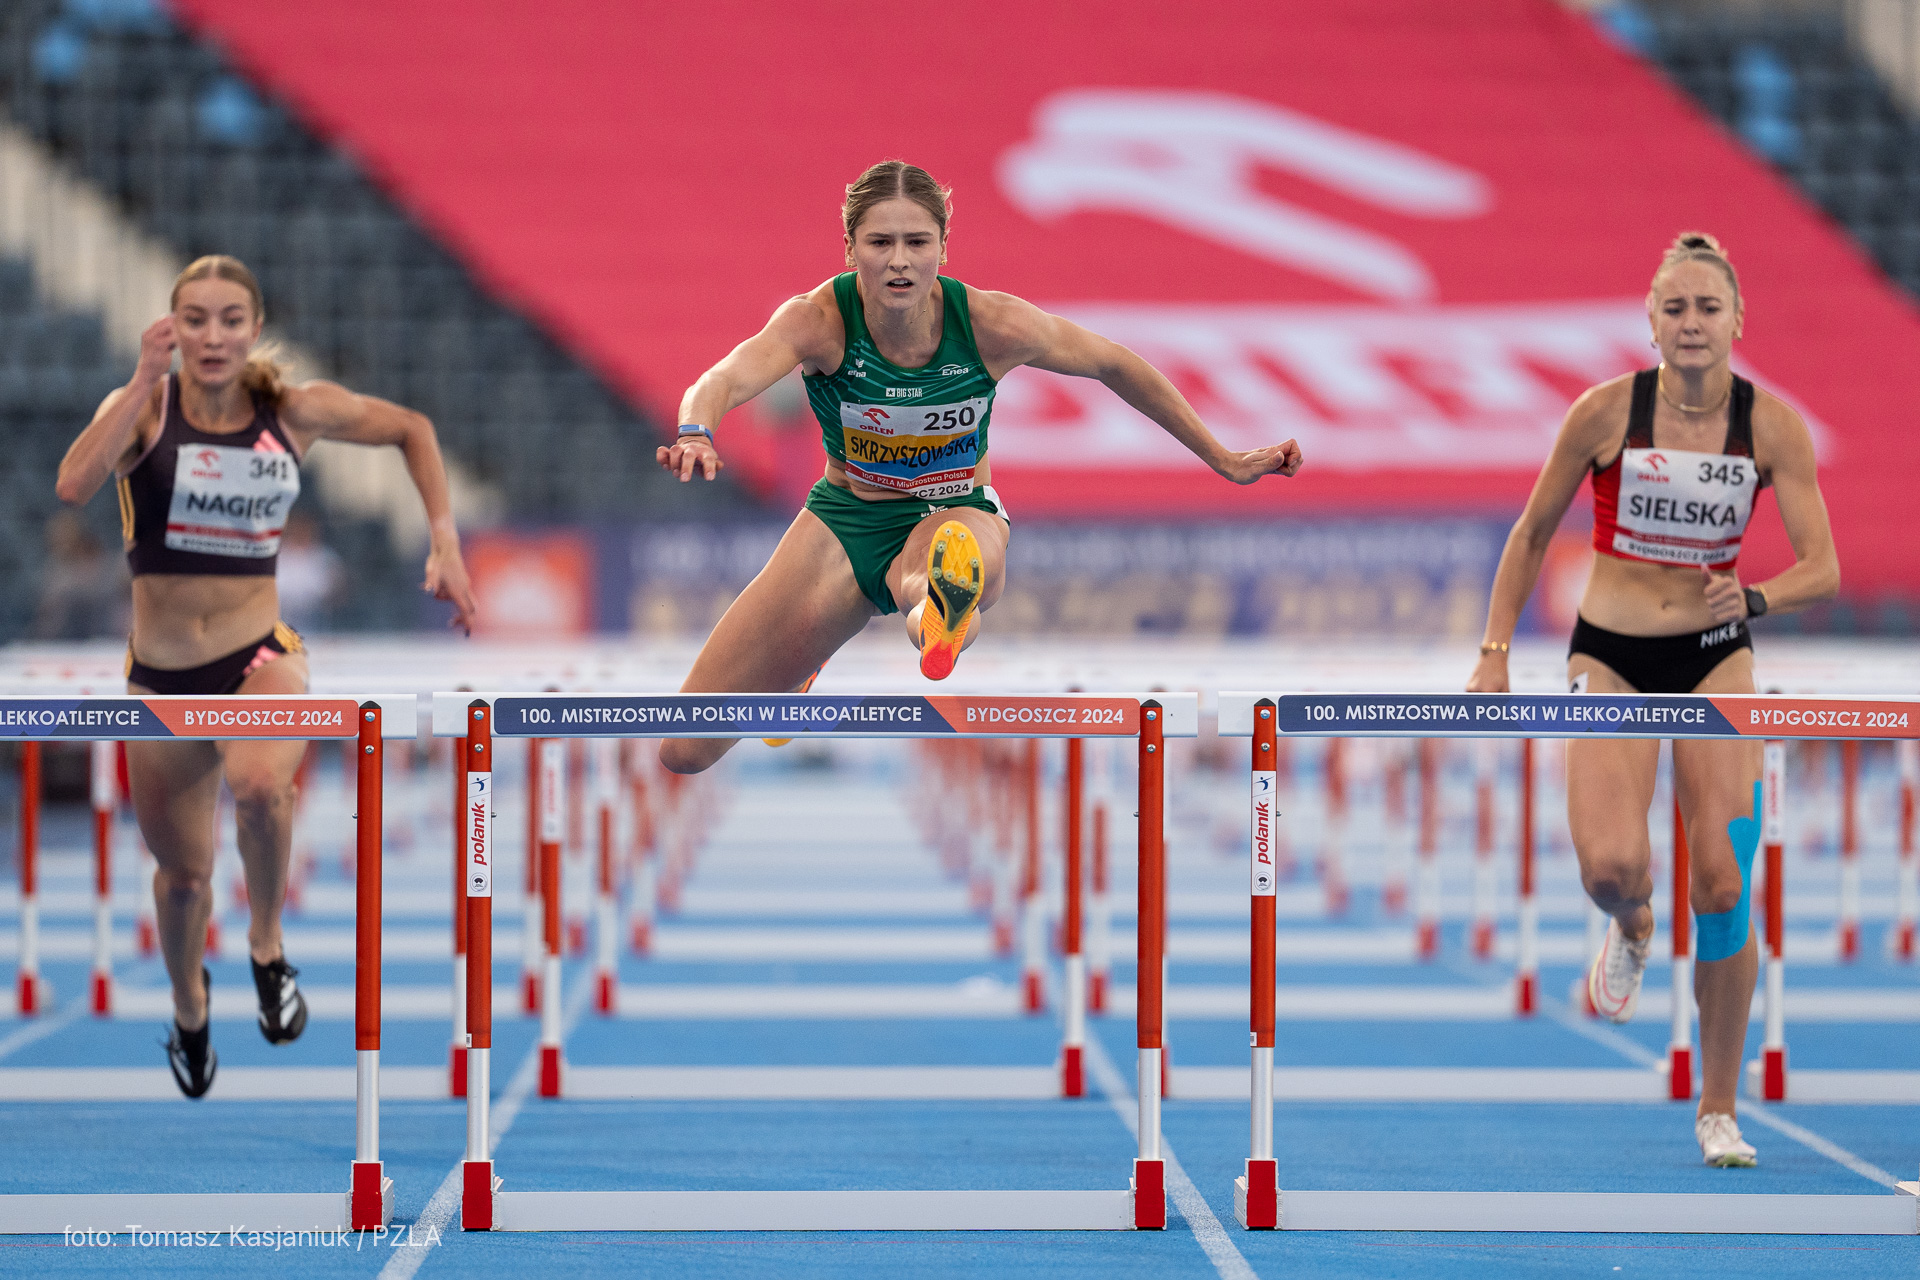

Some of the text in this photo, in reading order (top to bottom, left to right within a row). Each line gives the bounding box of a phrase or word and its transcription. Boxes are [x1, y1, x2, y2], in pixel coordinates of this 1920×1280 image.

[942, 366, 969, 376] Enea
[896, 388, 923, 397] BIG STAR
[859, 424, 894, 435] ORLEN
[923, 406, 976, 432] 250
[850, 435, 978, 469] SKRZYSZOWSKA
[249, 457, 288, 480] 341
[877, 477, 895, 486] PZLA
[943, 470, 967, 480] Polski
[1698, 462, 1744, 485] 345
[938, 483, 970, 496] 2024
[1629, 494, 1737, 527] SIELSKA
[1700, 621, 1739, 649] NIKE
[184, 710, 295, 726] BYDGOSZCZ
[300, 710, 343, 726] 2024
[520, 706, 1124, 724] 100. MISTRZOSTWA POLSKI W LEKKOATLETYCE BYDGOSZCZ 2024
[1304, 704, 1909, 728] 100. MISTRZOSTWA POLSKI W LEKKOATLETYCE BYDGOSZCZ 2024
[471, 802, 488, 866] polanik
[1255, 801, 1272, 865] polanik
